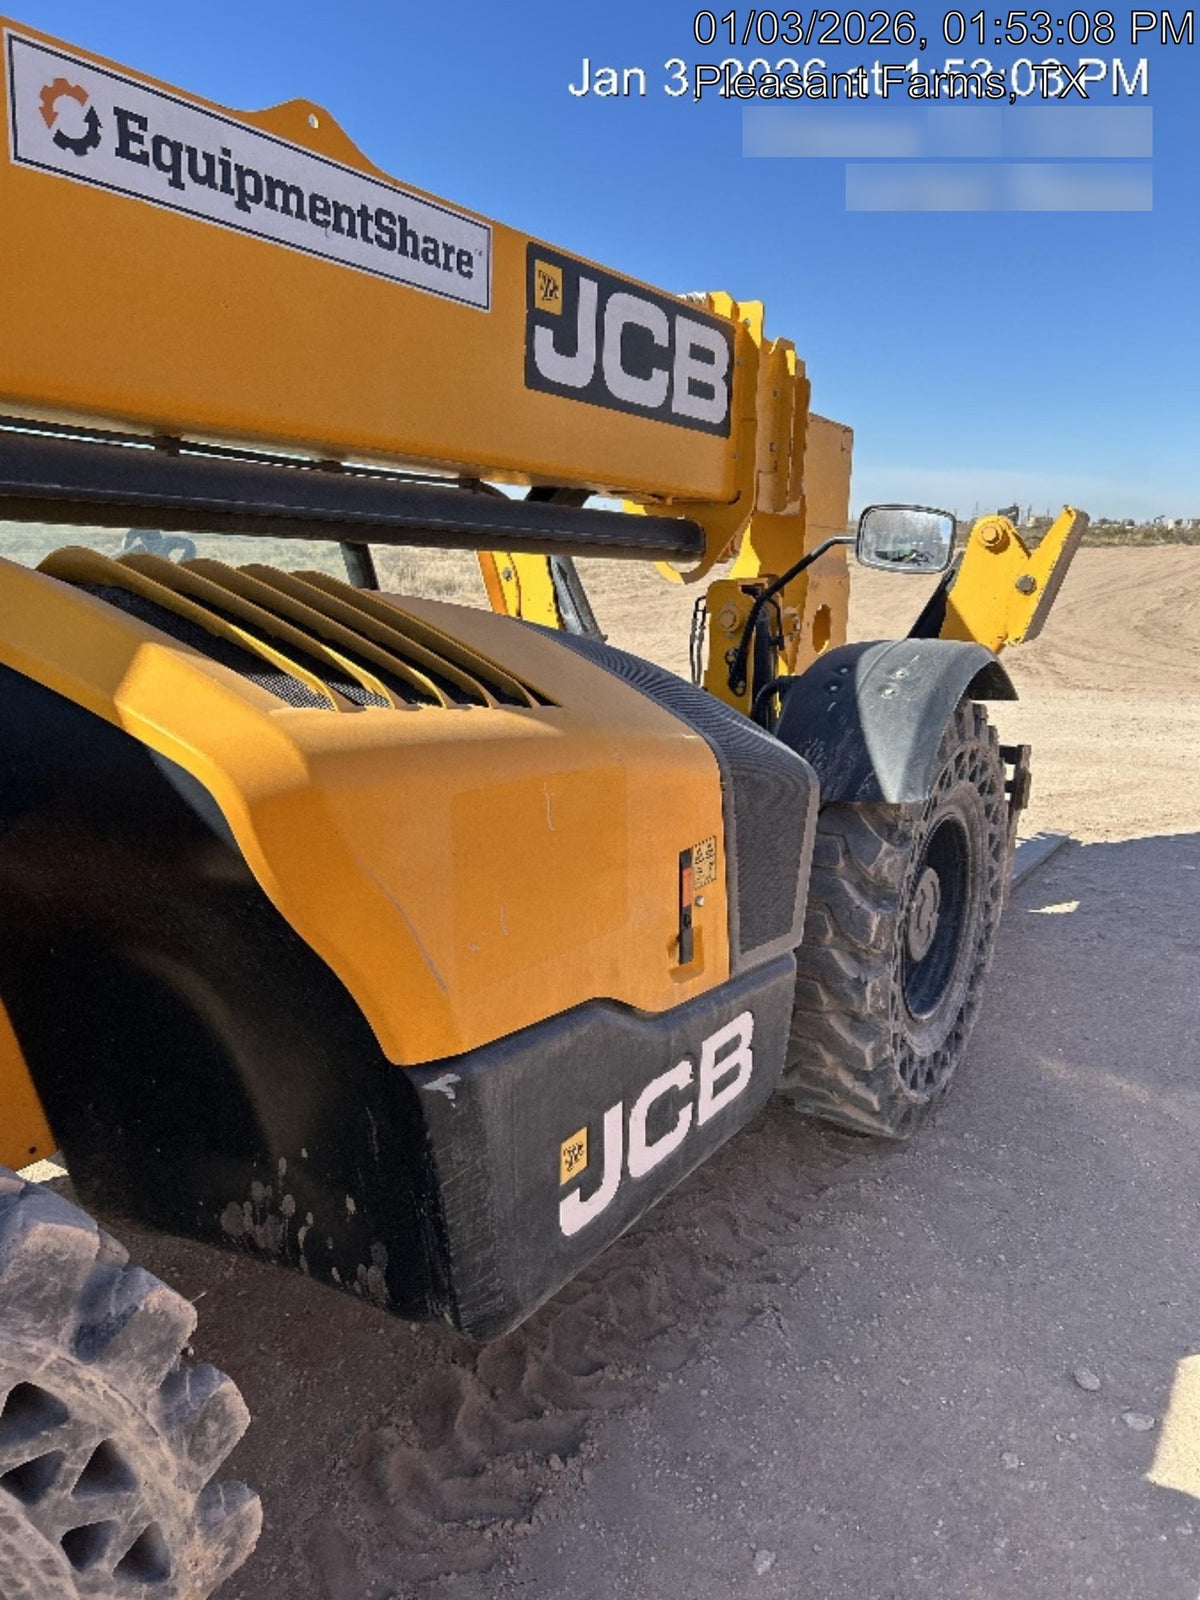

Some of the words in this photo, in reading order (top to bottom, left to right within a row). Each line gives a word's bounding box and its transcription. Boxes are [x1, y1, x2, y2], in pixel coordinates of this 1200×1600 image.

[113, 105, 474, 280] EquipmentShare
[534, 276, 729, 424] JCB
[559, 1010, 755, 1236] JCB
